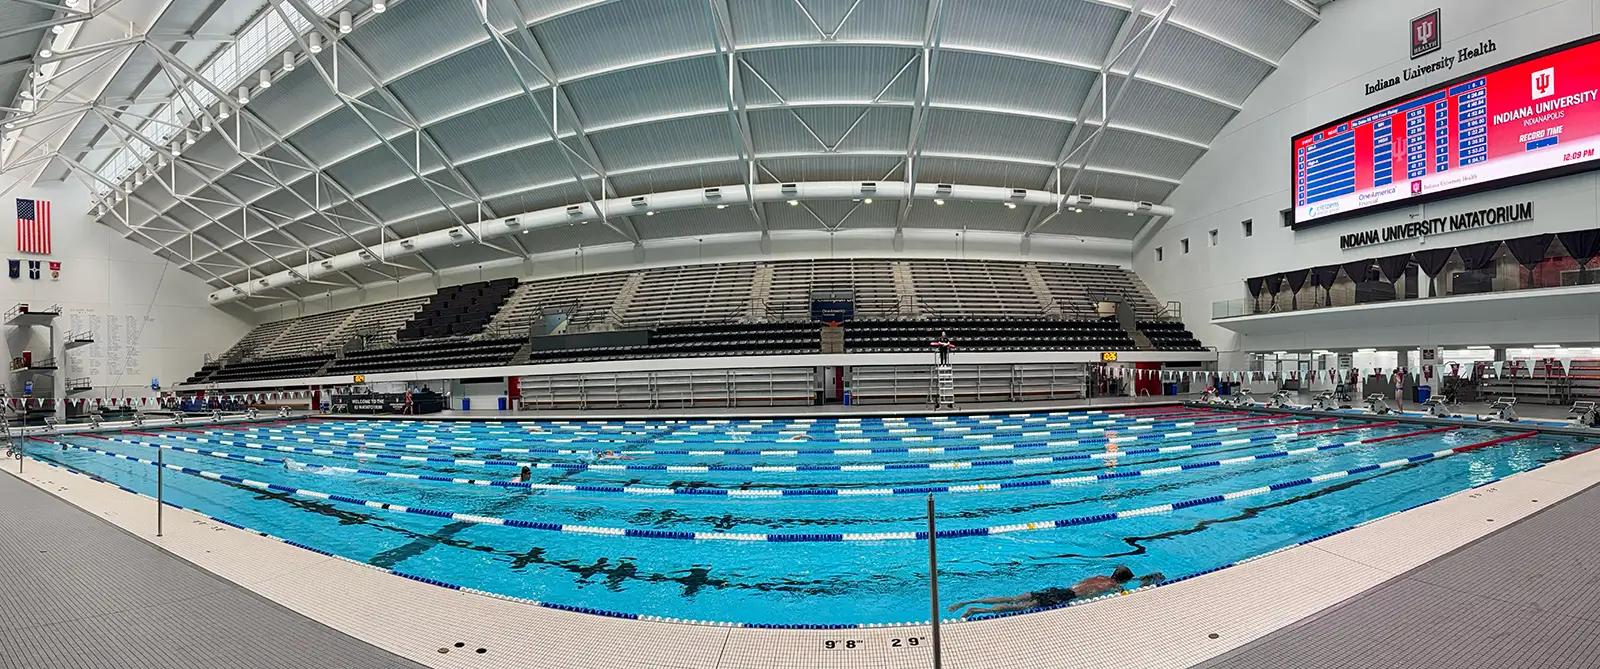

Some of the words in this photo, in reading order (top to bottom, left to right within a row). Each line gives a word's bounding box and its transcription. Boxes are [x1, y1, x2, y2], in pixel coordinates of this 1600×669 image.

[1413, 40, 1438, 54] HEALTH
[1364, 76, 1401, 95] Indiana
[1402, 55, 1455, 81] University
[1457, 39, 1497, 63] Health
[1493, 105, 1534, 125] INDIANA
[1535, 89, 1598, 114] UNIVERSITY
[1523, 110, 1565, 126] INDIANAPOLIS
[1519, 129, 1545, 142] RECORD
[1546, 125, 1563, 136] TIME
[1563, 151, 1582, 161] 12:09
[1583, 148, 1595, 158] PM
[1440, 178, 1461, 188] University
[1462, 174, 1478, 182] Health
[1359, 188, 1396, 201] OneAmerica
[1340, 229, 1380, 249] INDIANA
[1382, 217, 1447, 242] UNIVERSITY
[1450, 201, 1532, 231] NATATORIUM
